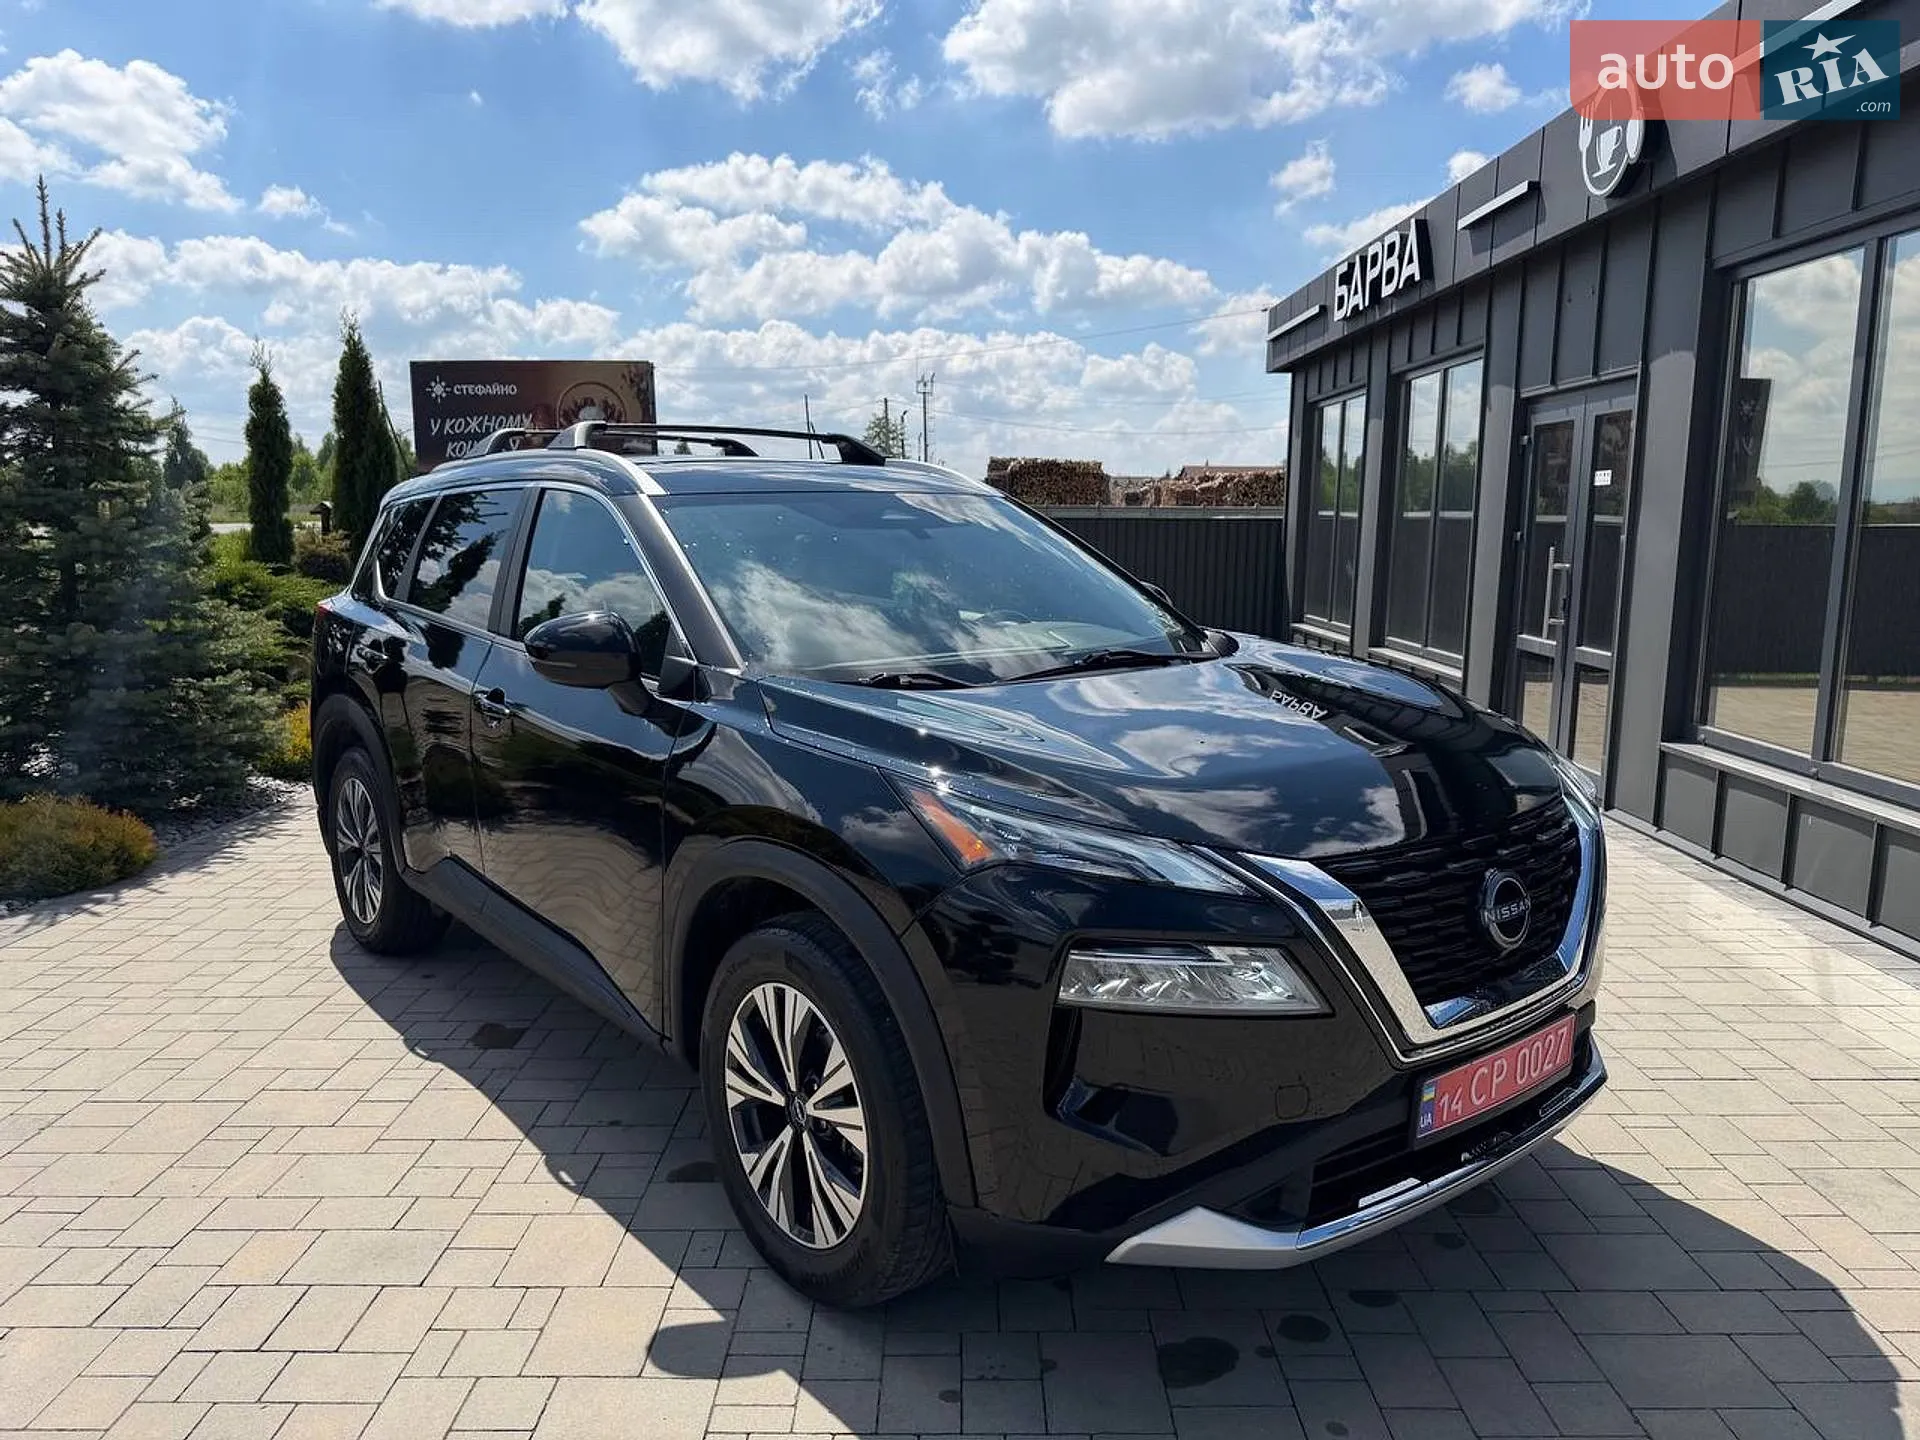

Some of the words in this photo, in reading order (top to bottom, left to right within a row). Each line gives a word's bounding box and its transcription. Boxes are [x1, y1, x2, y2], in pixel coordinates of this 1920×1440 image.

[1334, 217, 1420, 321] БАРВА
[453, 382, 518, 396] СТЕФАЙНО
[430, 418, 441, 435] У
[444, 413, 533, 435] КОЖНОМУ
[1439, 1086, 1463, 1122] 14
[1516, 1025, 1568, 1085] 0027
[1420, 1116, 1433, 1128] UA
